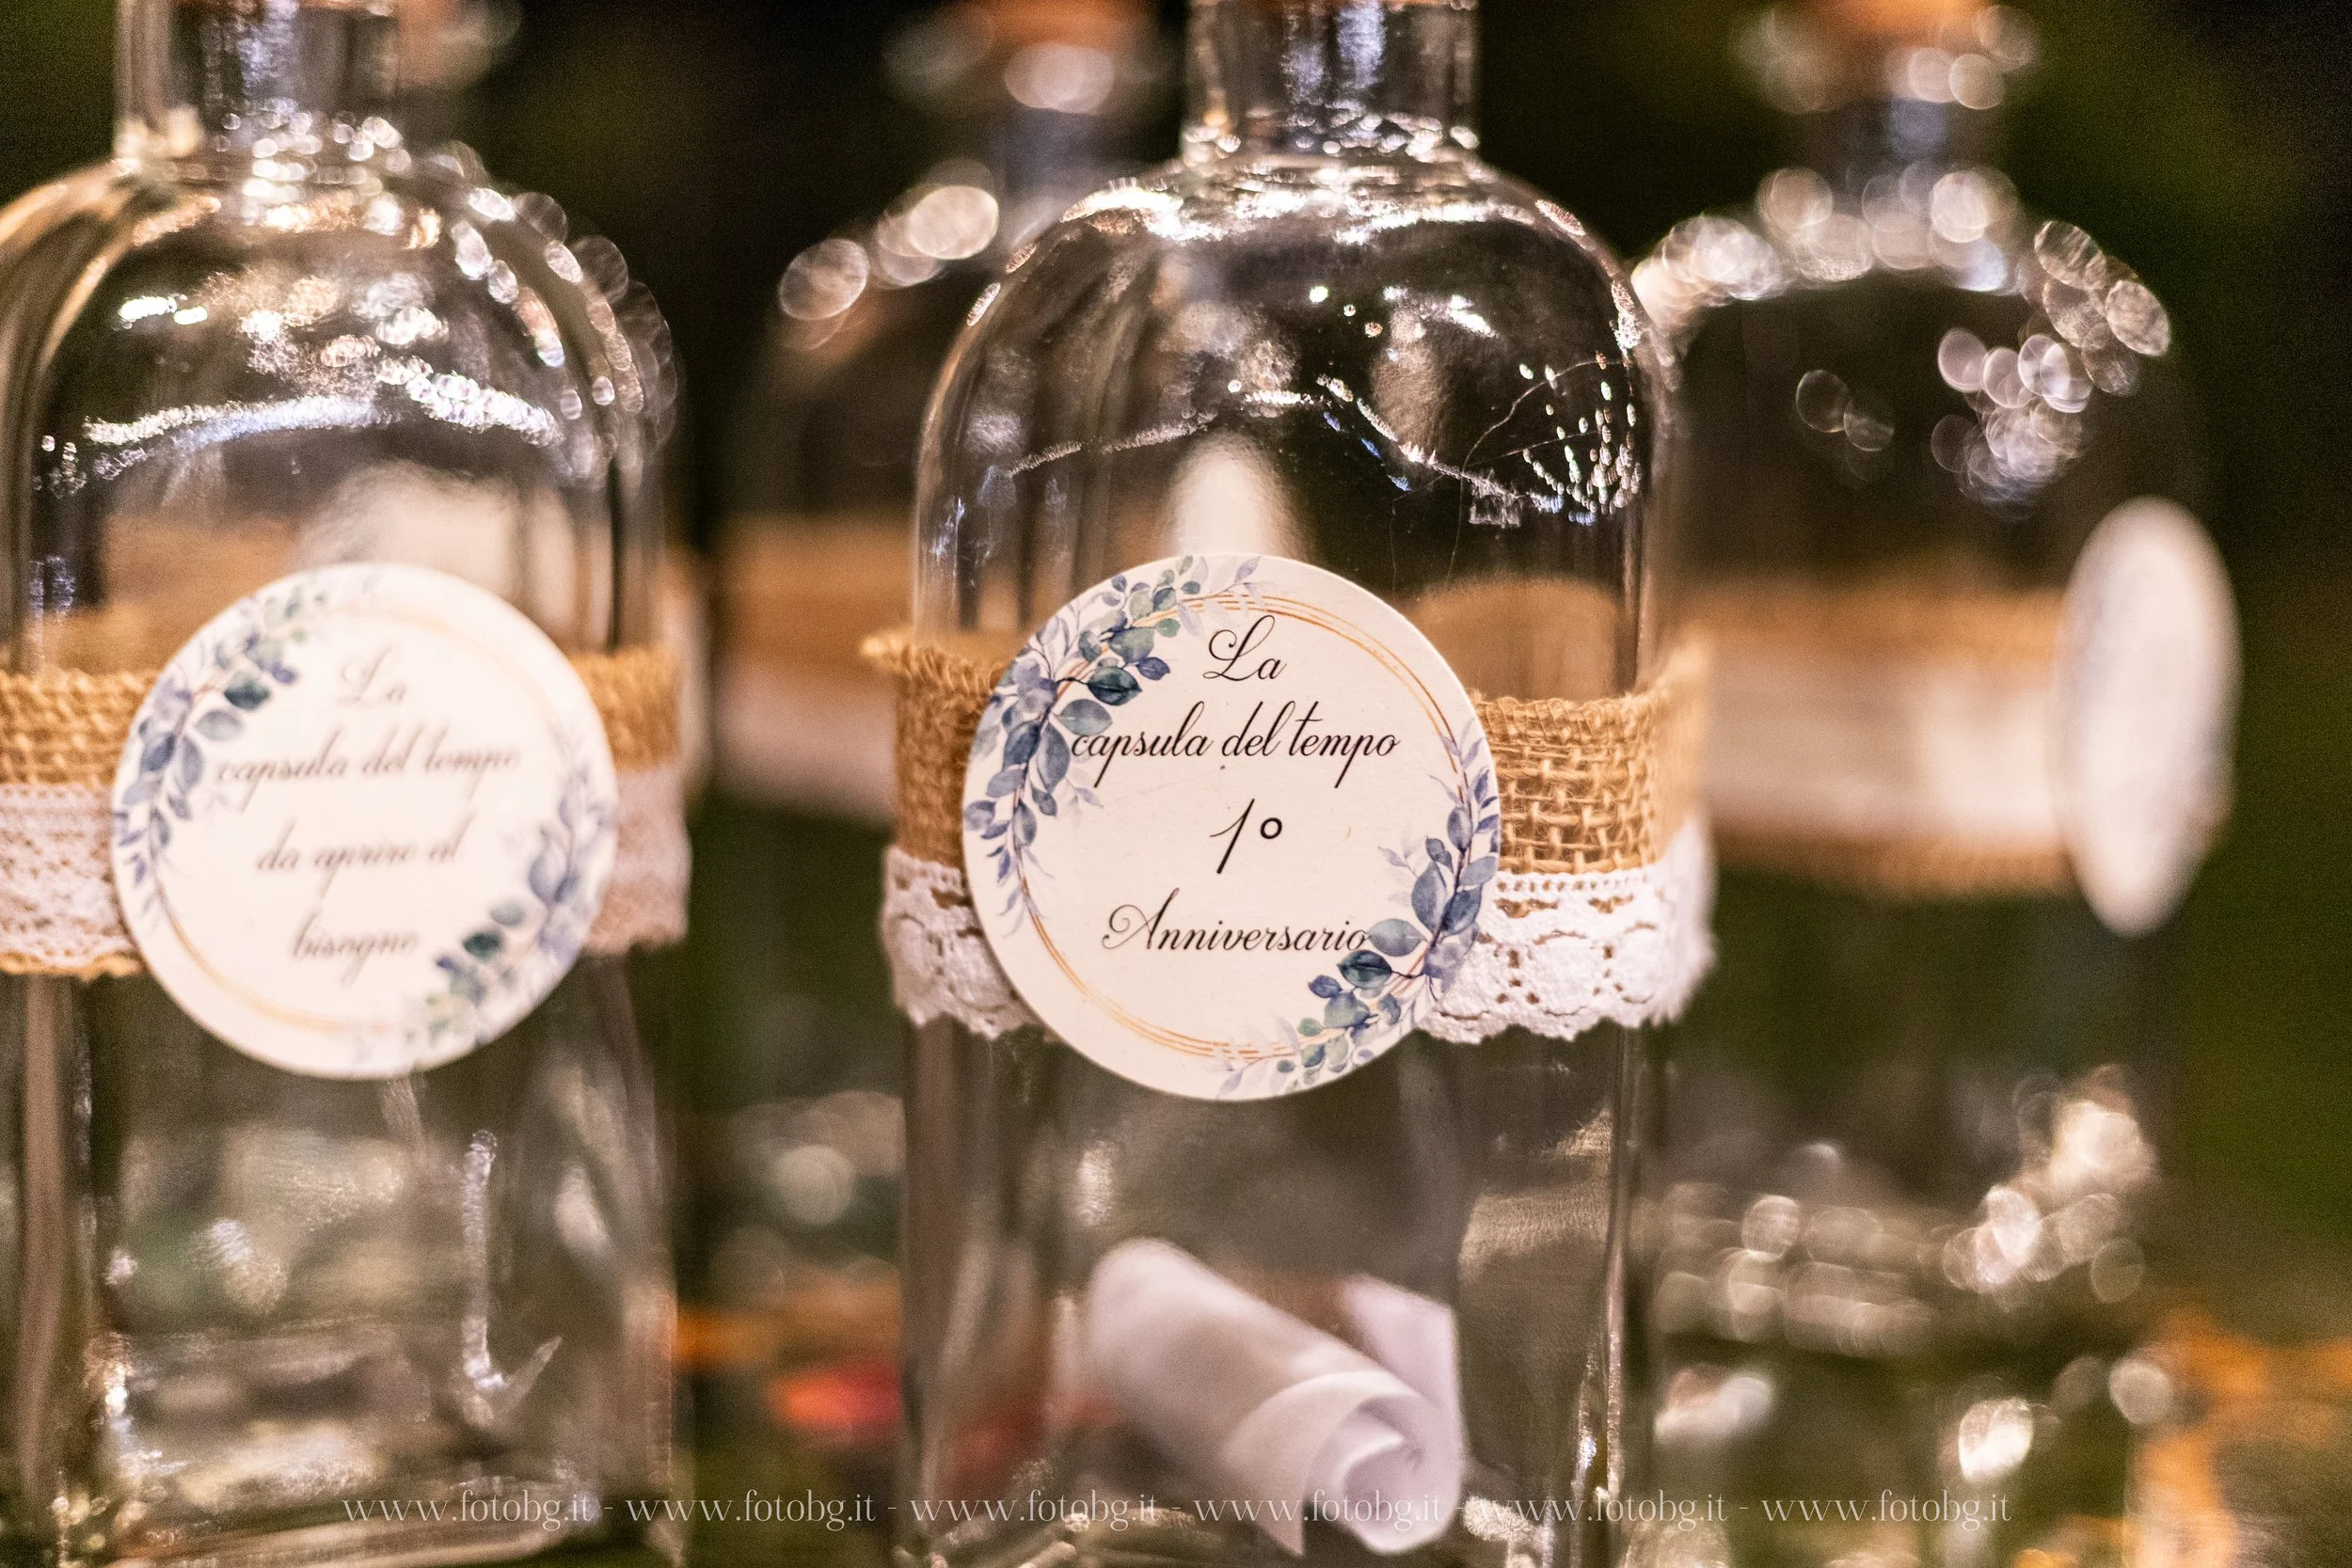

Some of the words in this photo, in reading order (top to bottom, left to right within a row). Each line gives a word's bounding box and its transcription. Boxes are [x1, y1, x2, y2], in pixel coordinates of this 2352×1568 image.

[333, 644, 408, 707] La
[1201, 614, 1286, 682] La
[215, 726, 350, 813] capsula
[359, 722, 425, 774] del
[422, 722, 521, 803] tempo
[1071, 701, 1213, 788] capsula
[1220, 701, 1295, 758] del
[1287, 701, 1401, 788] tempo
[255, 816, 301, 872] da
[1210, 798, 1282, 874] 1°
[290, 907, 421, 986] bisogno
[1102, 887, 1370, 953] Anniversario
